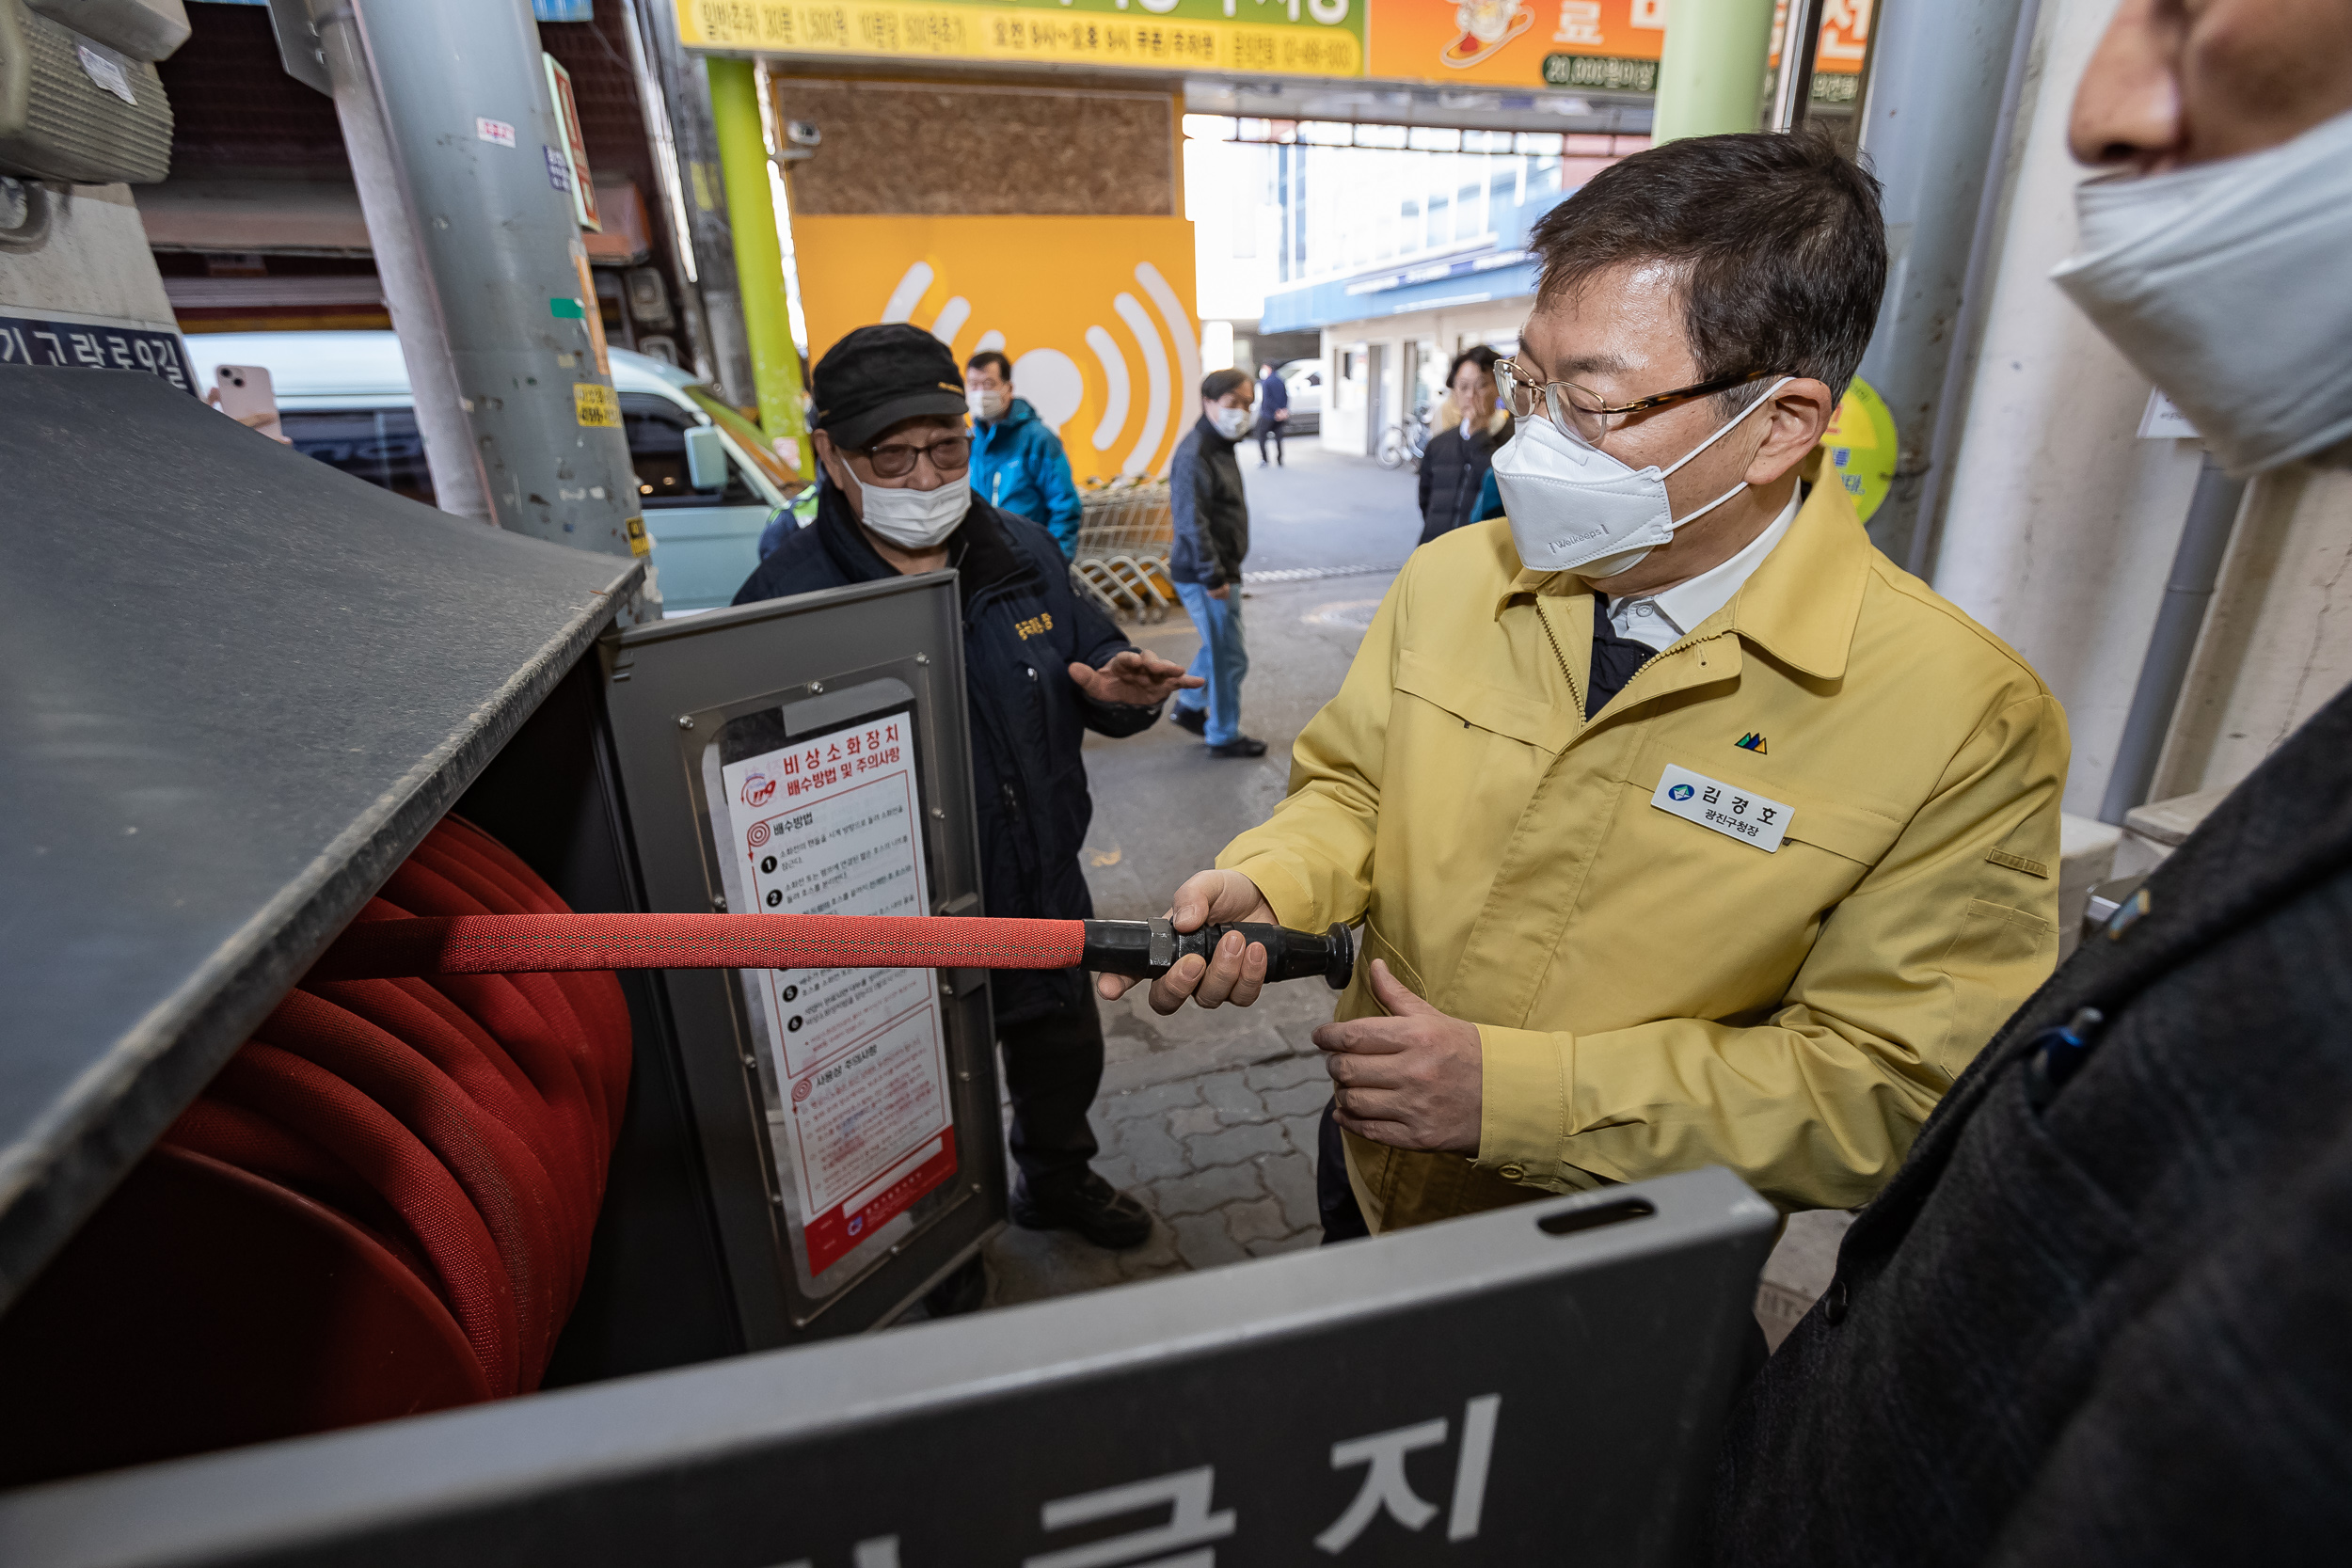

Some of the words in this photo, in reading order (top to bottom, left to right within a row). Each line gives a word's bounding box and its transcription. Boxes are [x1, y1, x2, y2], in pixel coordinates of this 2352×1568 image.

[1554, 529, 1602, 549] Welkeeps
[784, 722, 899, 775] 비상소화장치
[787, 767, 837, 797] 배수방법
[840, 762, 852, 779] 및
[856, 746, 900, 773] 주의사항
[1702, 785, 1777, 826] 김경호
[1705, 808, 1759, 837] 광진구청장
[773, 811, 814, 836] 배수방법
